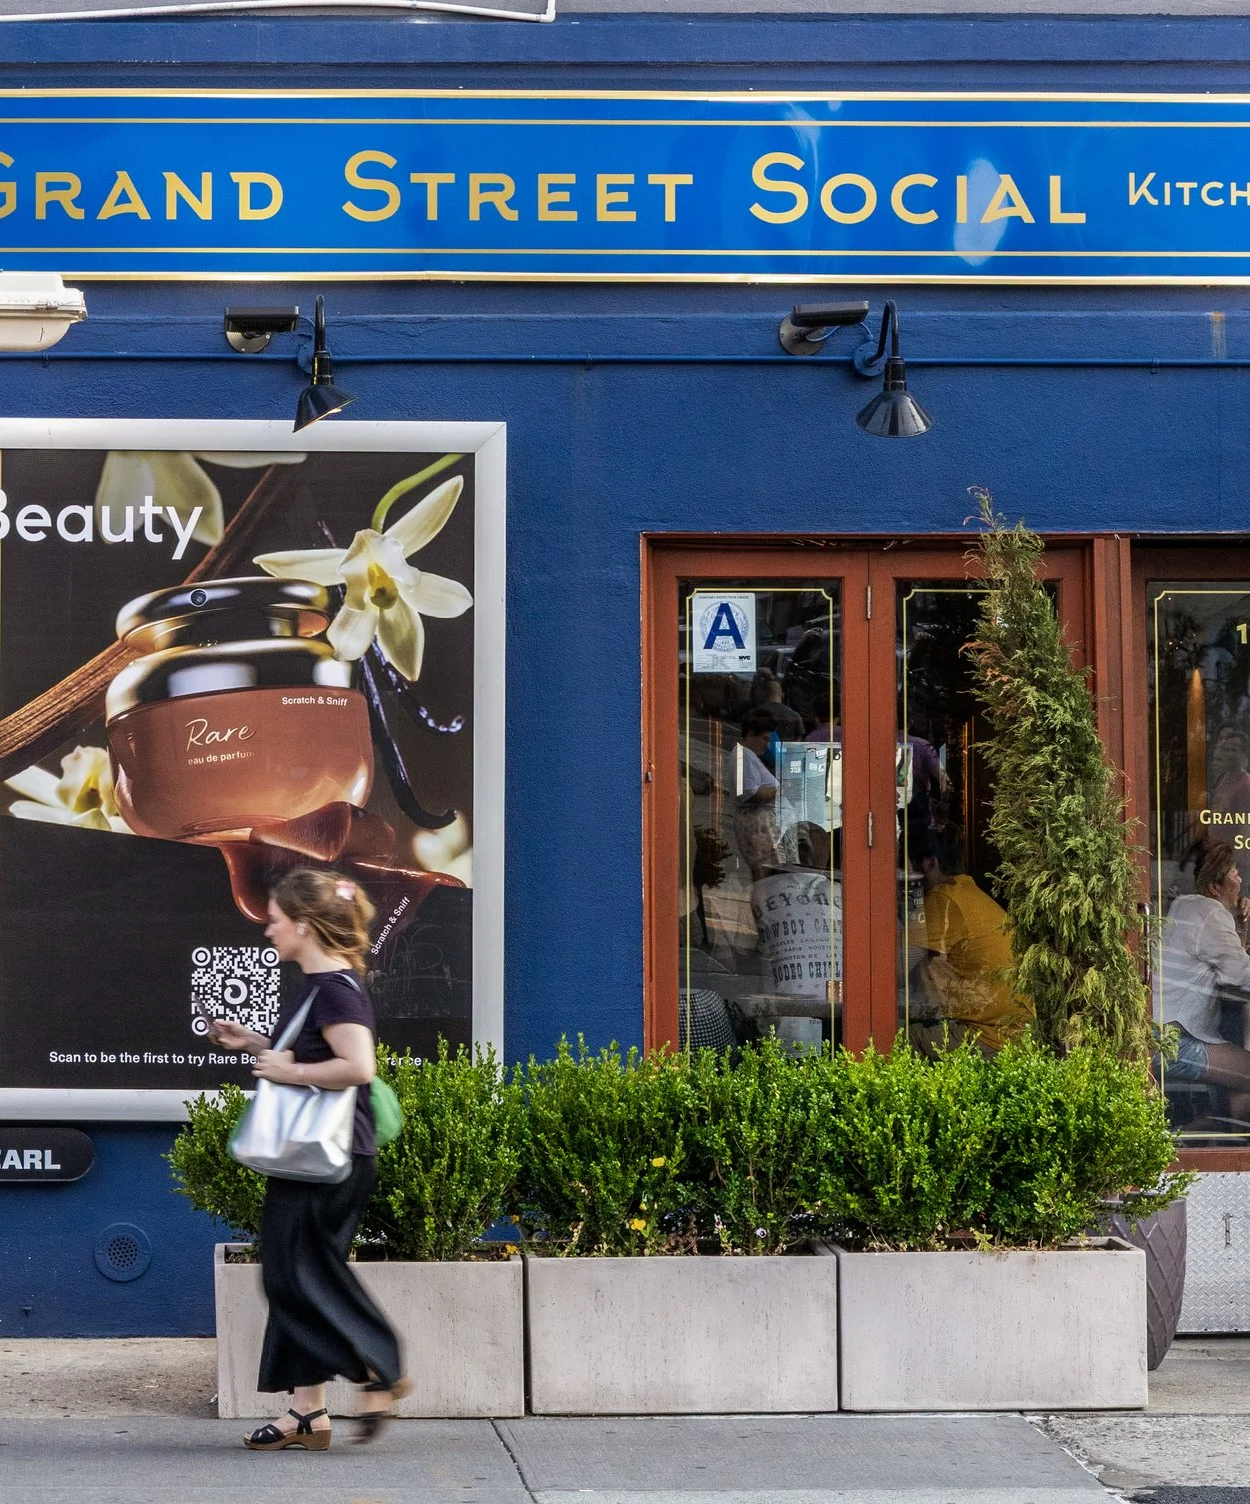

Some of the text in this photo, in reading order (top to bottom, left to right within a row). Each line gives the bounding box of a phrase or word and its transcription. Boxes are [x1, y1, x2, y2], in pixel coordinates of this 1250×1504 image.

[342, 149, 693, 223] STREET
[749, 151, 1086, 225] SOCIAL
[703, 603, 746, 649] A
[282, 696, 316, 705] Scratch
[326, 697, 347, 706] Sniff
[185, 718, 257, 752] Rare
[188, 757, 204, 766] eau
[206, 754, 218, 763] de
[371, 896, 411, 955] Scratch & Sniff
[49, 1052, 81, 1063] Scan
[84, 1053, 97, 1063] to
[100, 1052, 116, 1063] be
[120, 1052, 140, 1063] the
[143, 1052, 169, 1064] first
[172, 1053, 185, 1064] to
[188, 1053, 205, 1066] try
[209, 1054, 237, 1065] Rare
